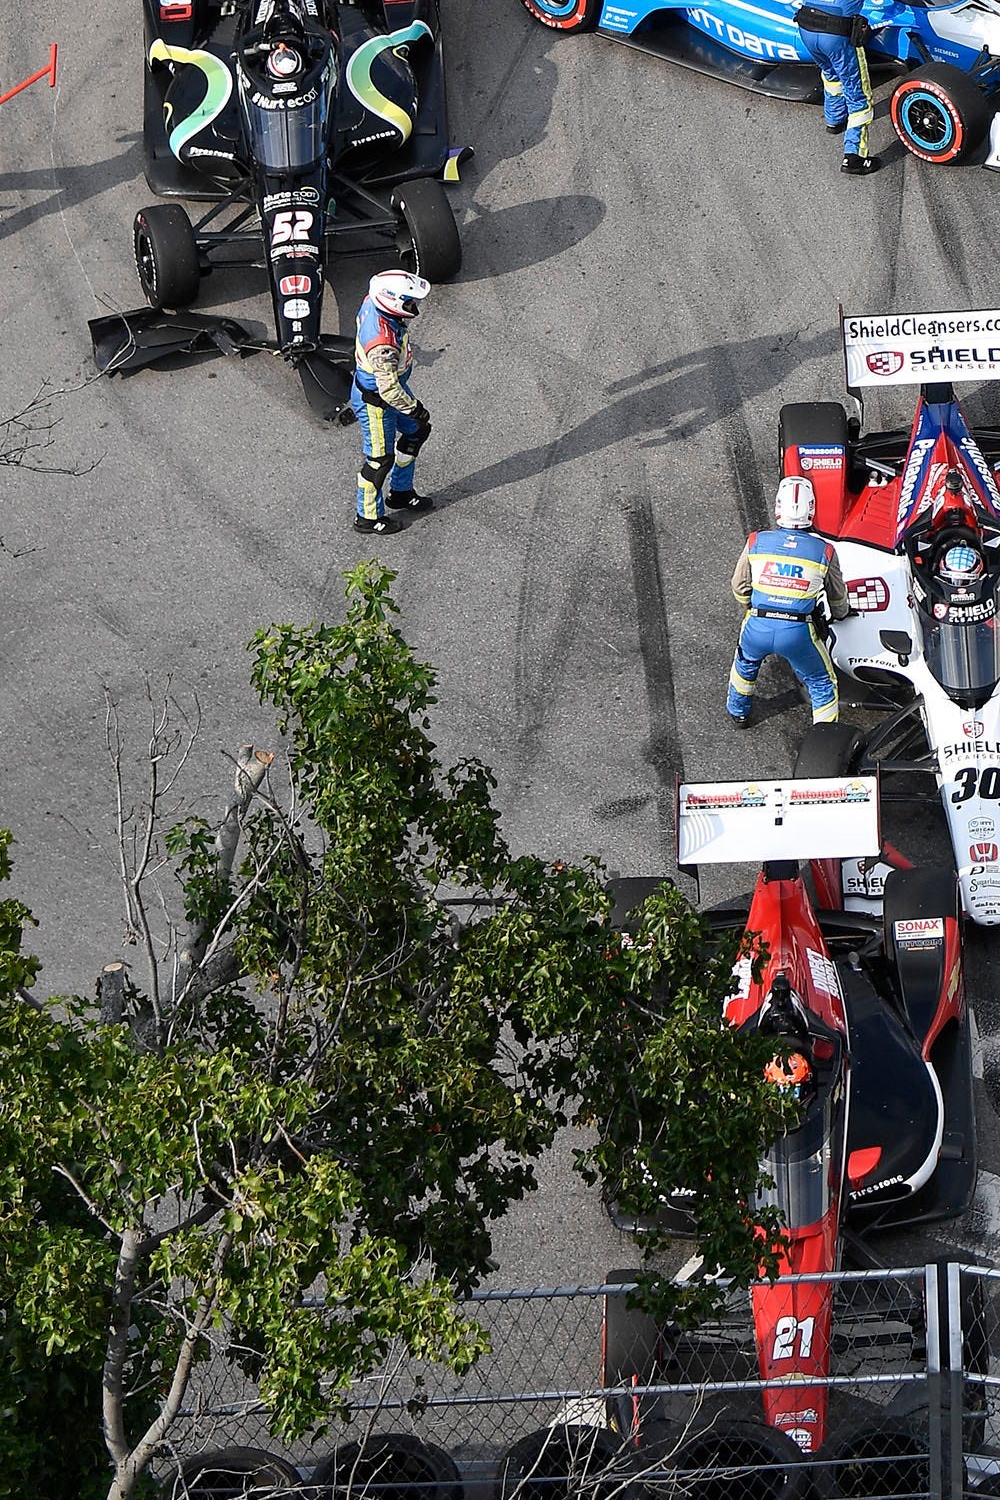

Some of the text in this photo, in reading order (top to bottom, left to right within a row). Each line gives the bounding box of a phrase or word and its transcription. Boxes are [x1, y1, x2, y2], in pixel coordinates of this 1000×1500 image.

[933, 46, 960, 59] SIEMENS
[271, 210, 314, 246] 52
[798, 446, 844, 456] Panasonic
[812, 457, 843, 468] SHIELD
[896, 438, 936, 523] Panasonic
[949, 598, 995, 618] SHIELD
[847, 656, 897, 669] Firestone
[897, 919, 939, 932] SONAX
[849, 1174, 904, 1200] Firestone
[772, 1316, 815, 1360] 21
